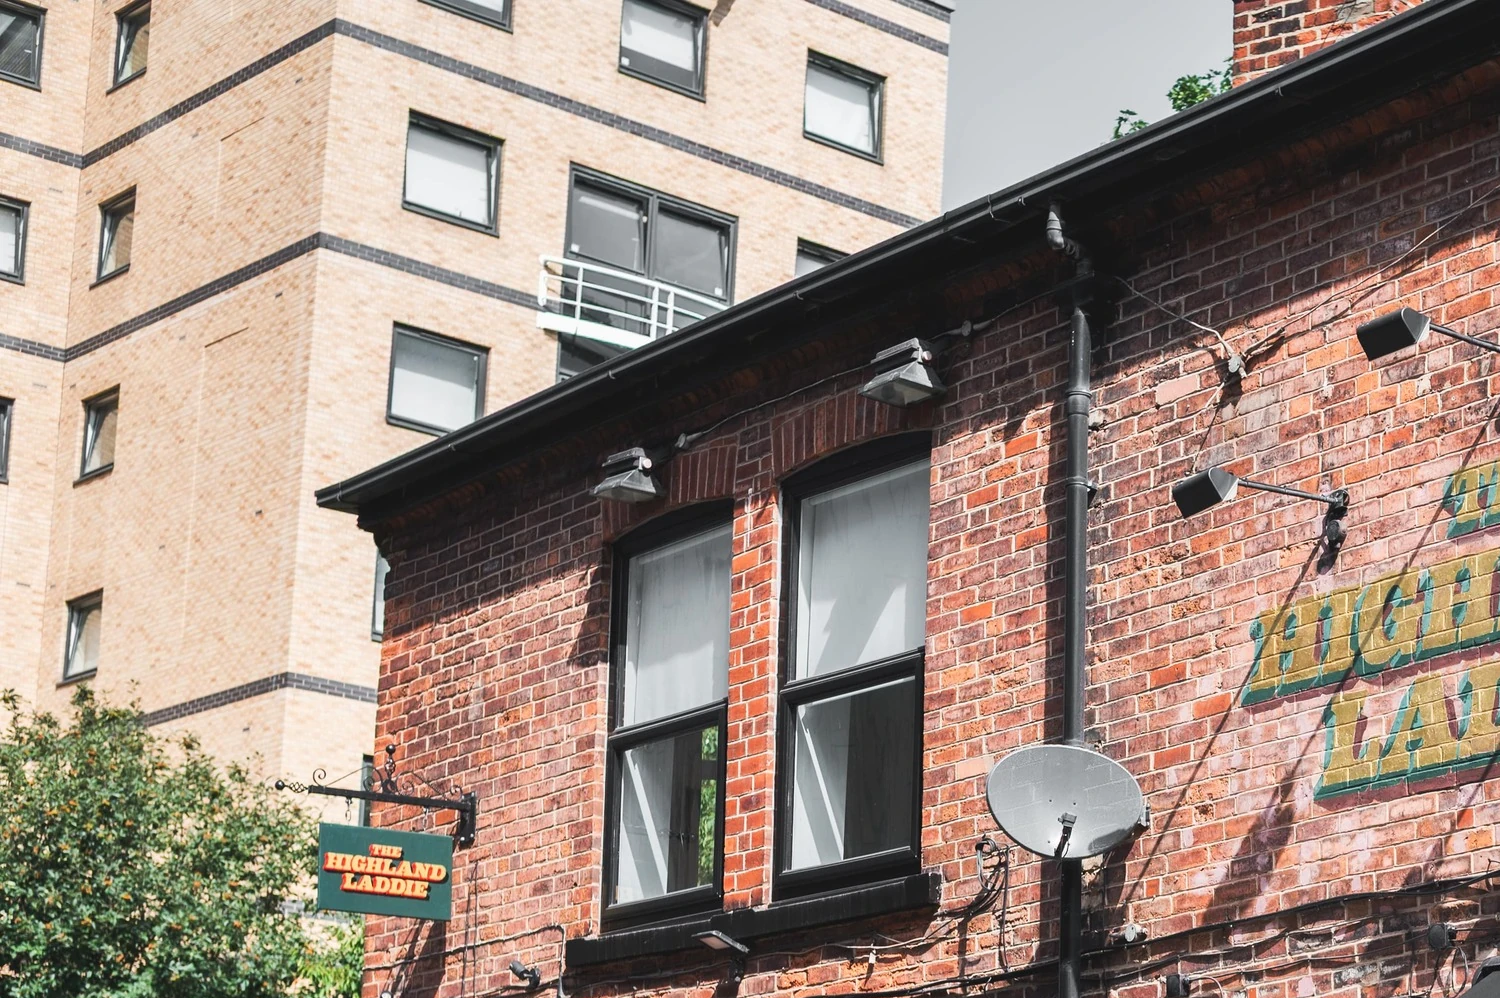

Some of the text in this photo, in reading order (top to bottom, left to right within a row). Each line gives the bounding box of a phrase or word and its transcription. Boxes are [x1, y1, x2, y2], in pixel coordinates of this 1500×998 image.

[369, 843, 403, 858] THE
[323, 852, 447, 883] HIGHLAND
[341, 873, 429, 898] LADDIE
